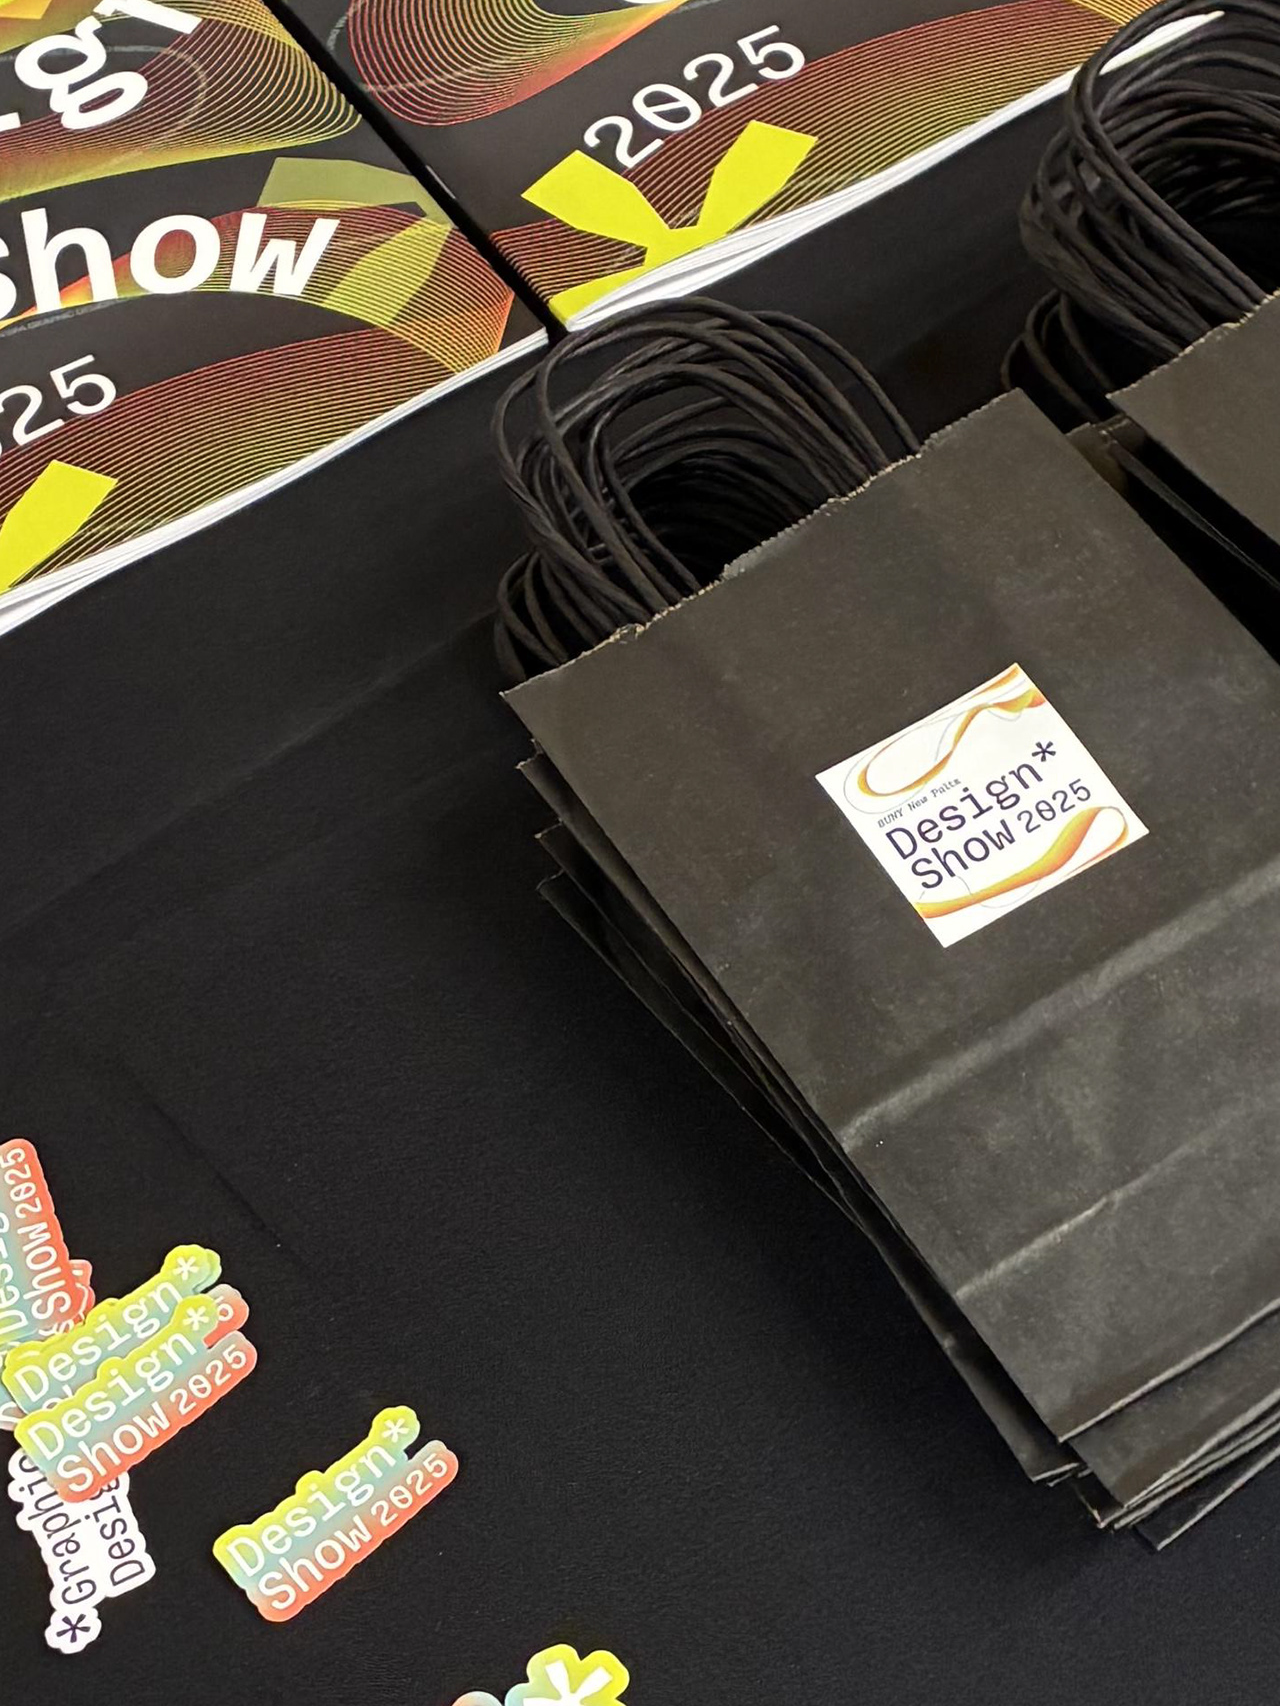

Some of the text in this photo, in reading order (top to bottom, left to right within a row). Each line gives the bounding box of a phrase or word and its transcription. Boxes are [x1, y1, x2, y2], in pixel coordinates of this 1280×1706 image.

[583, 25, 806, 168] 2025
[910, 778, 1092, 890] Show 2025
[17, 1220, 72, 1319] Show
[56, 1344, 246, 1494] Show 2025
[257, 1452, 449, 1611] Show 2025
